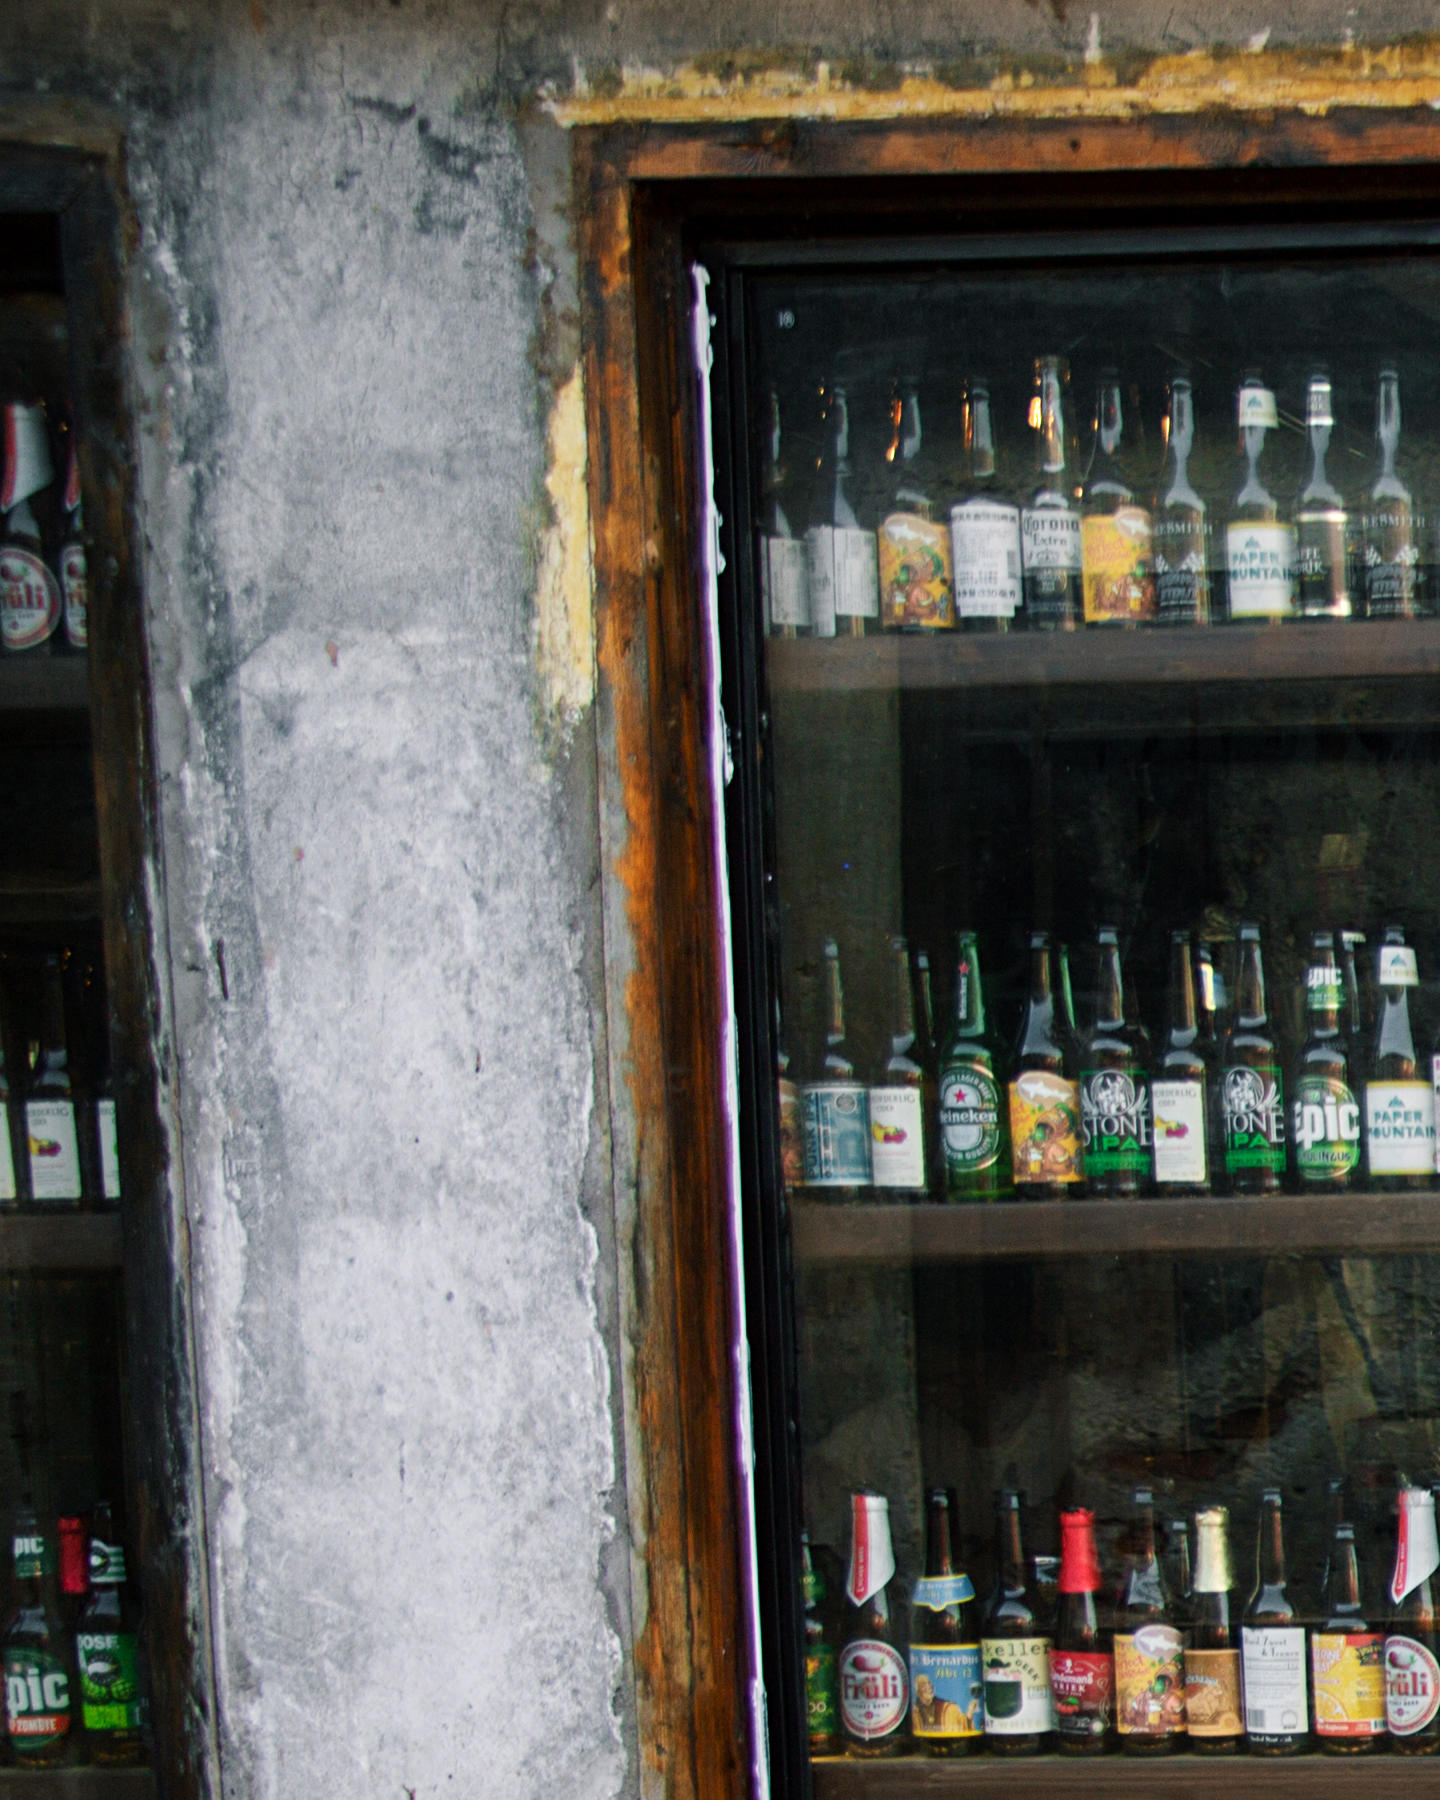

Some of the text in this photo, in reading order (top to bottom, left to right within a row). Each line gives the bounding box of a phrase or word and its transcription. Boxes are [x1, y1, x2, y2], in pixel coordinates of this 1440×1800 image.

[1023, 516, 1079, 536] Corona
[1231, 551, 1279, 565] PAPER
[1374, 1111, 1422, 1122] PAPER
[1081, 1113, 1152, 1147] STONE
[1224, 1112, 1285, 1142] TONE
[1094, 1135, 1141, 1152] IPA
[841, 1673, 898, 1699] Früli
